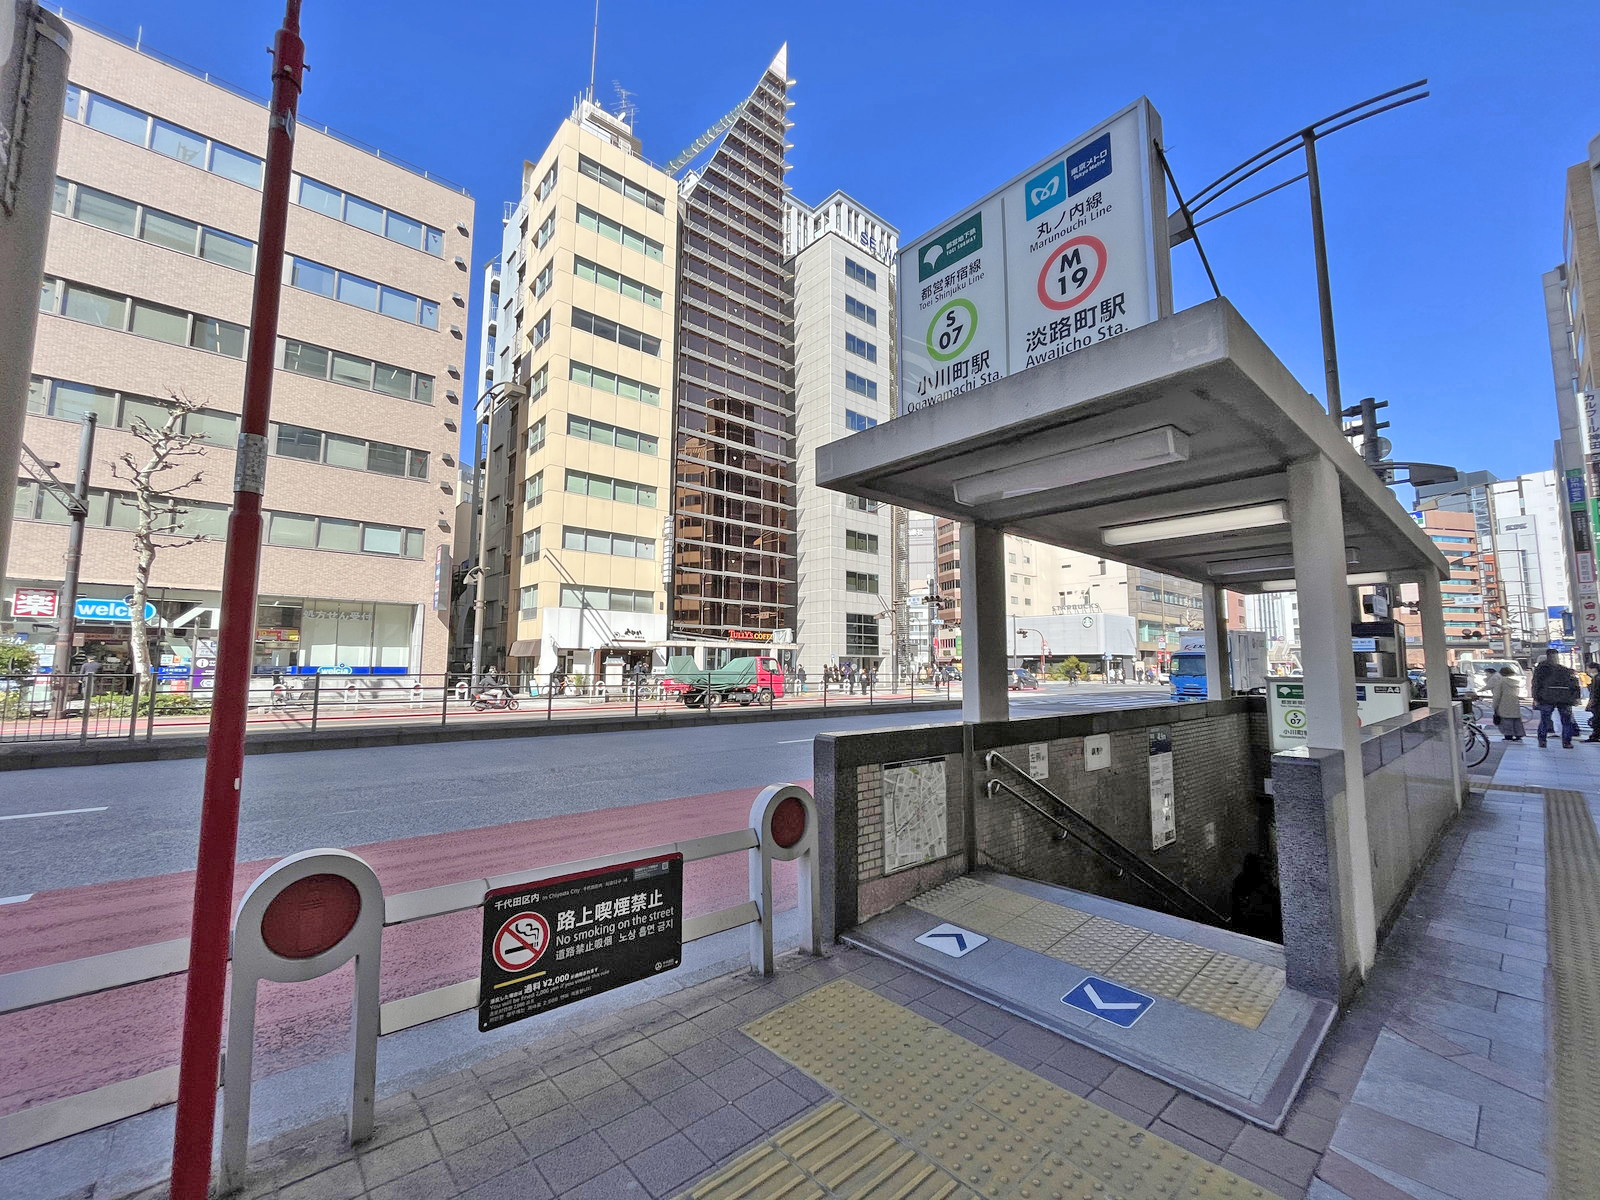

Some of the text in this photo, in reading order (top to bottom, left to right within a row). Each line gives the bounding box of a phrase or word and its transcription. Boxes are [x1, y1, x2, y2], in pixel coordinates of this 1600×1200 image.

[1070, 149, 1108, 176] 東京メトロ
[1073, 158, 1106, 180] Tokyo Metro
[1030, 203, 1113, 253] Marunouchi Line
[1037, 192, 1102, 239] 丸ノ内線
[1060, 248, 1082, 273] M
[918, 272, 984, 311] Toei Shinjuku Line
[921, 258, 982, 302] 都営新宿線
[1058, 267, 1088, 295] 19
[946, 310, 956, 328] S
[1026, 292, 1126, 352] 淡路町駅
[939, 324, 963, 350] 07
[1026, 322, 1129, 368] Awajicho Sta.
[917, 350, 990, 396] 小川町駅
[980, 371, 1004, 387] Sta.
[16, 589, 54, 615] 薬
[1052, 603, 1099, 612] STARBUCKS
[303, 610, 372, 621] 処方せん受付
[494, 894, 540, 911] 千代田区内
[570, 888, 580, 896] City
[556, 889, 664, 932] 路上喫煙禁止
[556, 907, 674, 947] No smoking on the street
[618, 930, 636, 942] 노상
[657, 919, 674, 932] 금지
[524, 982, 541, 994] 過料
[543, 974, 570, 988] ¥2,000
[536, 988, 550, 998] 2,000
